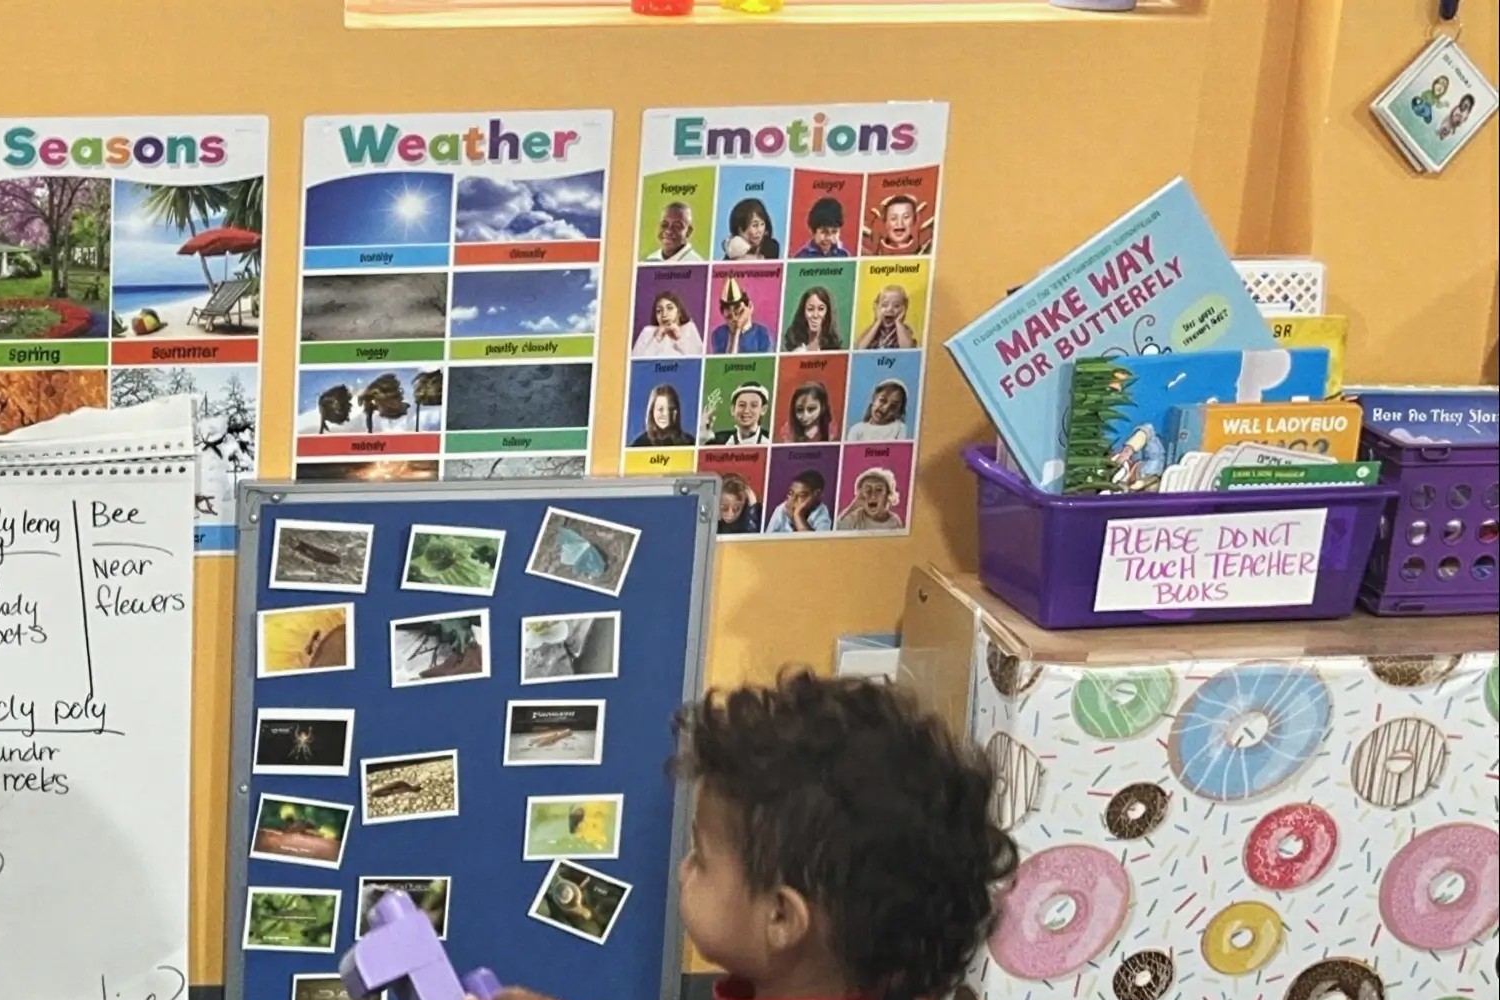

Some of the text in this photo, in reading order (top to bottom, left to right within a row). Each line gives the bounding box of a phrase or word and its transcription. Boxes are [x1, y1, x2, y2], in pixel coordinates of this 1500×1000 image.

[3, 126, 227, 168] Seasons
[339, 118, 580, 164] Weather
[673, 112, 916, 157] Emotions
[994, 235, 1156, 366] MAKE WAY
[1000, 352, 1054, 399] FOR
[1053, 256, 1183, 360] BUTTERFLY
[91, 501, 147, 528] Bee
[1108, 525, 1203, 557] PLEASE
[92, 558, 153, 579] Near
[1204, 550, 1317, 580] TEACHER
